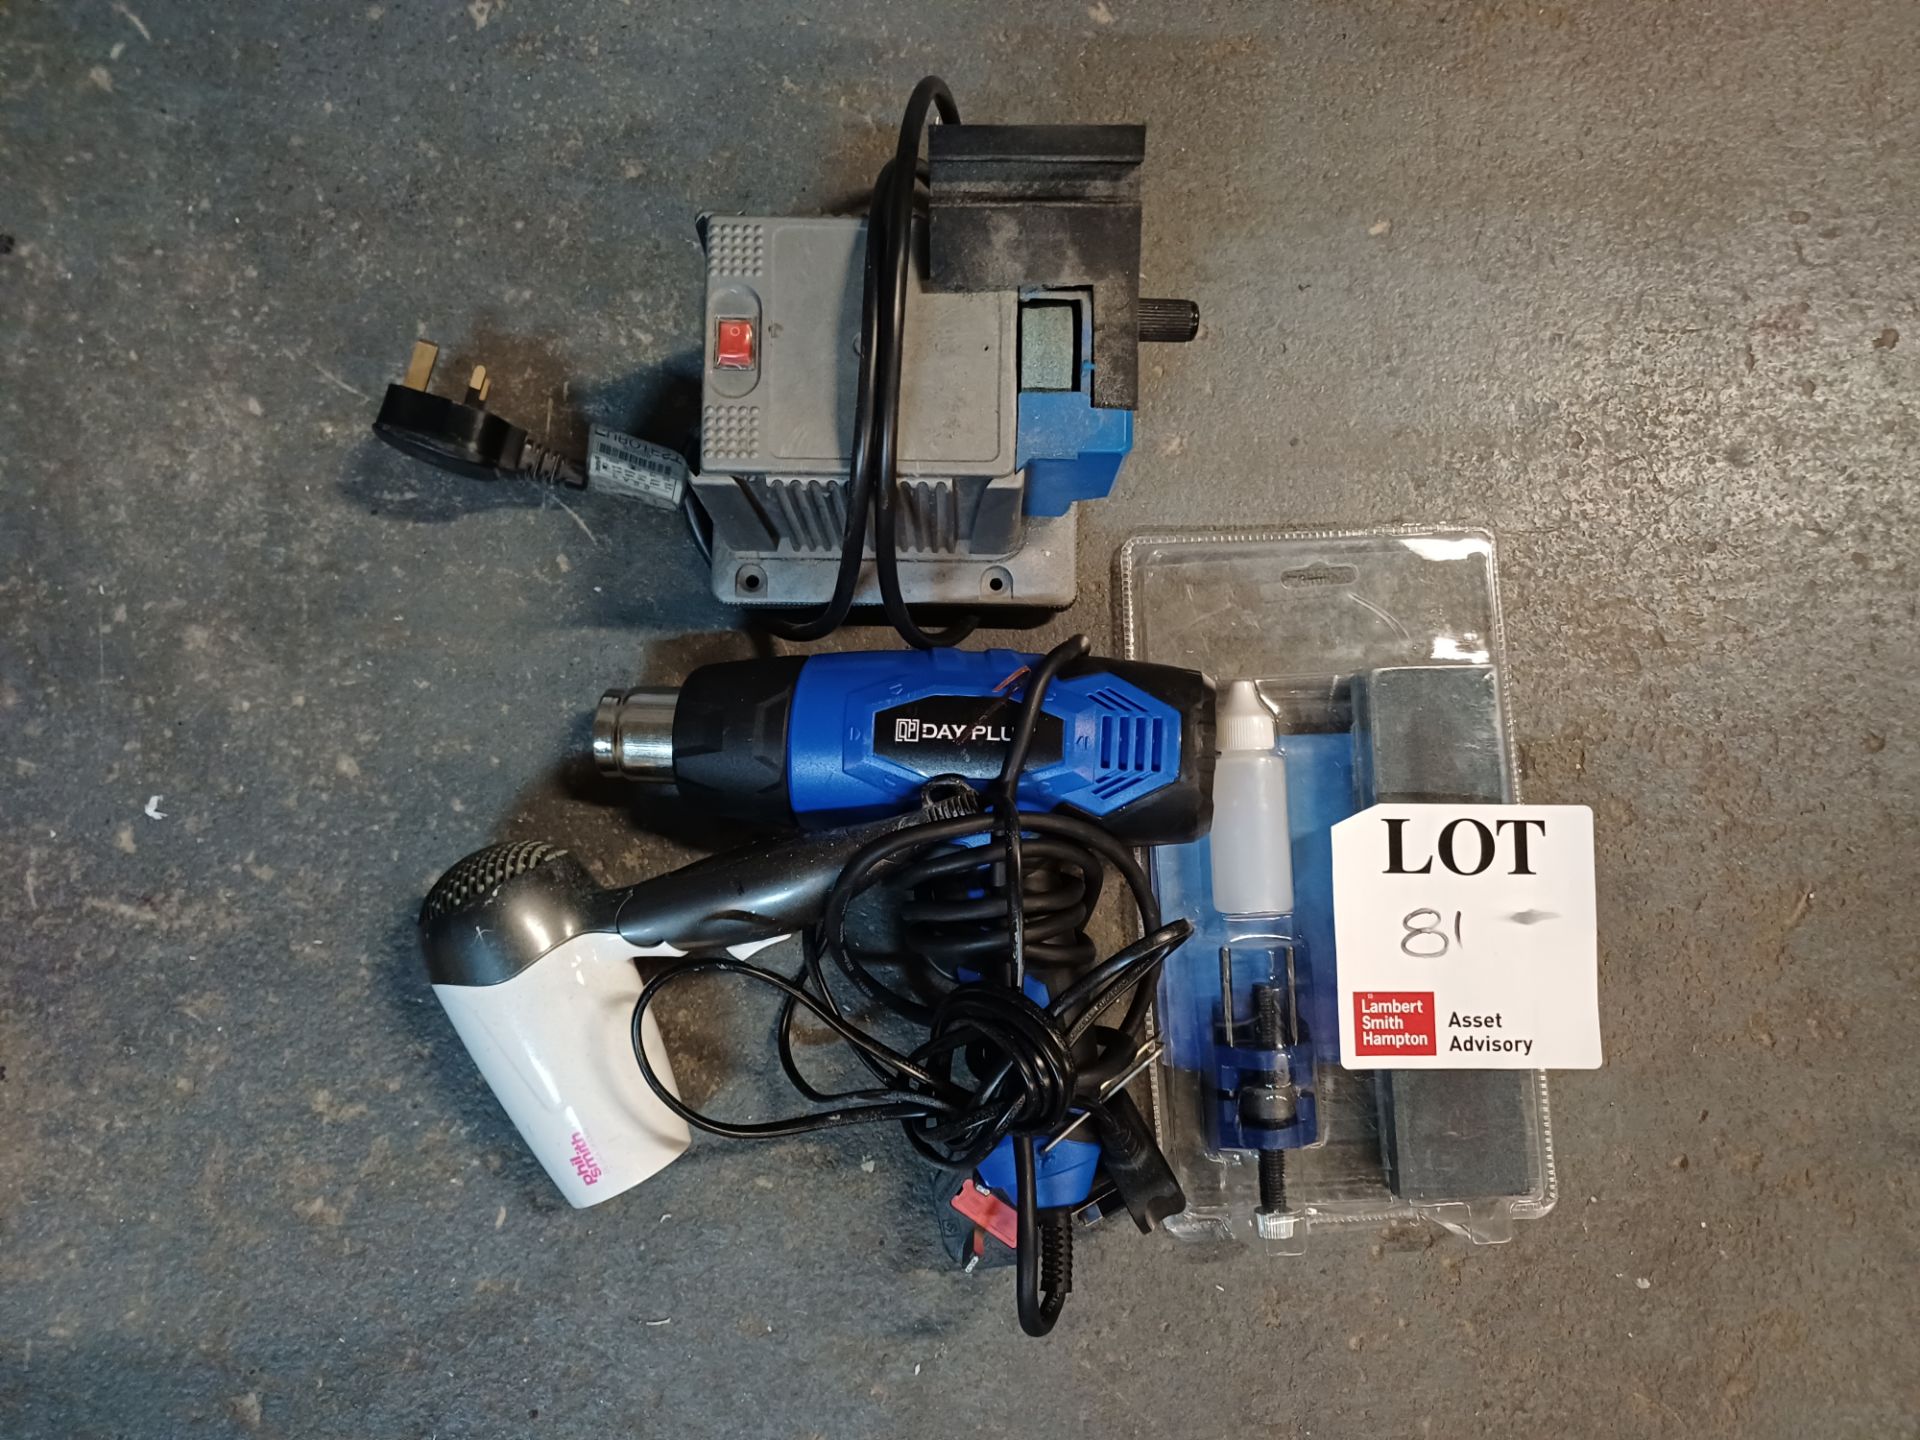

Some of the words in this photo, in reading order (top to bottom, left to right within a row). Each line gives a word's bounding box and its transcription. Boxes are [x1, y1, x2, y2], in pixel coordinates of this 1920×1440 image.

[922, 724, 967, 739] DAY
[1381, 818, 1546, 876] LOT
[1401, 908, 1463, 958] 81
[1361, 999, 1424, 1014] Lambert
[1362, 1015, 1404, 1030] Smith
[1448, 1011, 1503, 1028] Asset
[1362, 1032, 1428, 1048] Hampton
[1449, 1036, 1533, 1056] Advisory
[571, 1132, 602, 1178] smith
